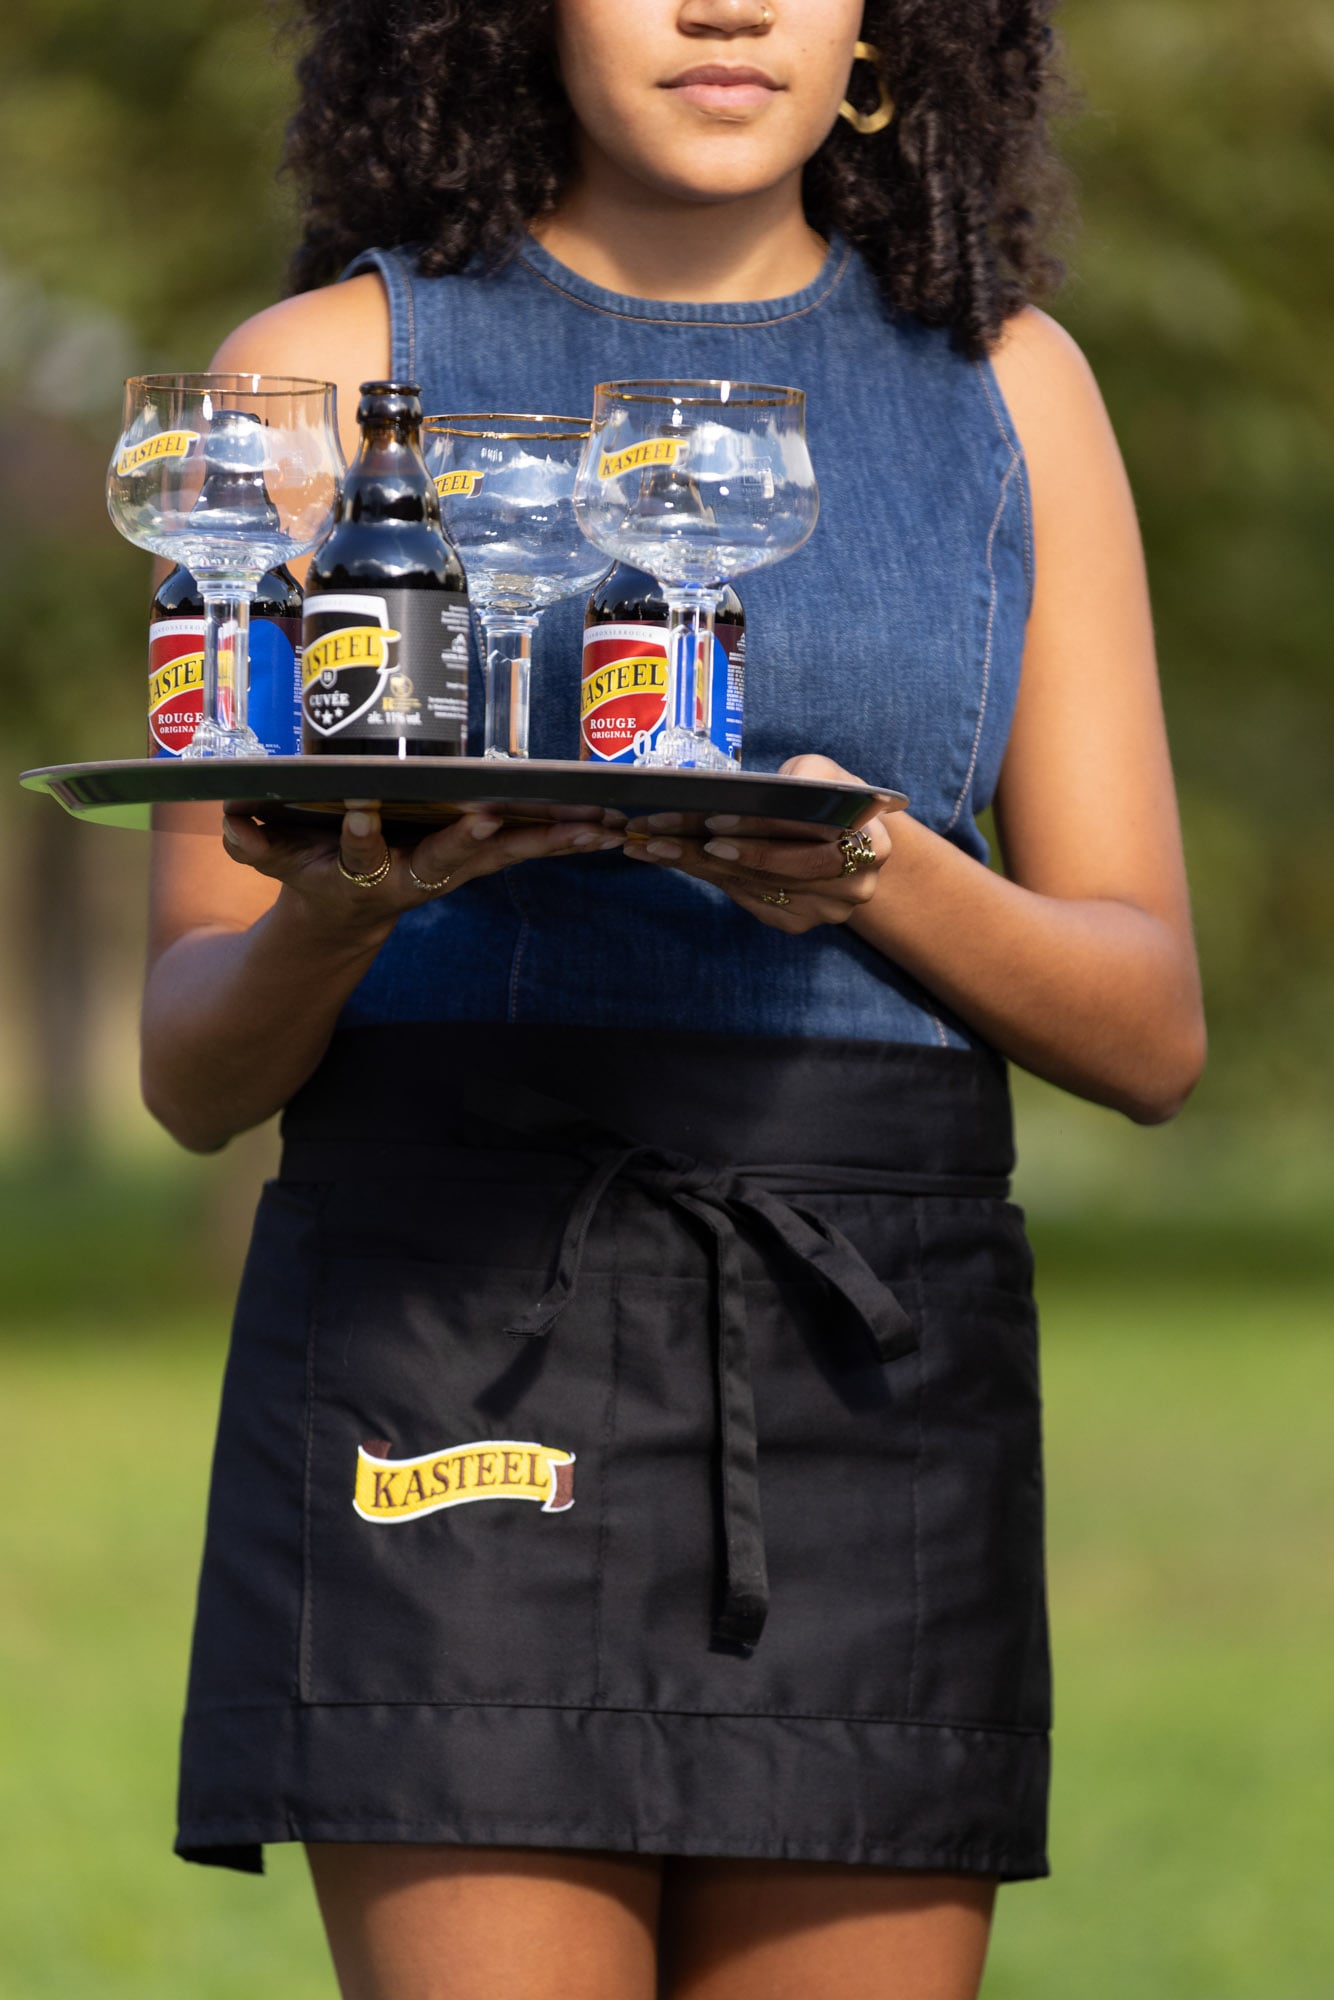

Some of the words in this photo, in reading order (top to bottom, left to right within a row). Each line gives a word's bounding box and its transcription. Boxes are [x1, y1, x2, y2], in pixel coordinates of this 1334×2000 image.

[121, 436, 184, 470] KASTEEL
[601, 442, 674, 476] KASTEEL
[435, 475, 470, 493] TEEL
[303, 634, 379, 677] ASTEEL
[149, 659, 206, 706] ASTE
[309, 690, 350, 707] CUVÉE
[157, 712, 204, 725] ROUGE
[589, 717, 637, 730] ROUGE
[591, 731, 633, 739] ORIGINAL
[371, 1451, 550, 1509] KASTEEL
